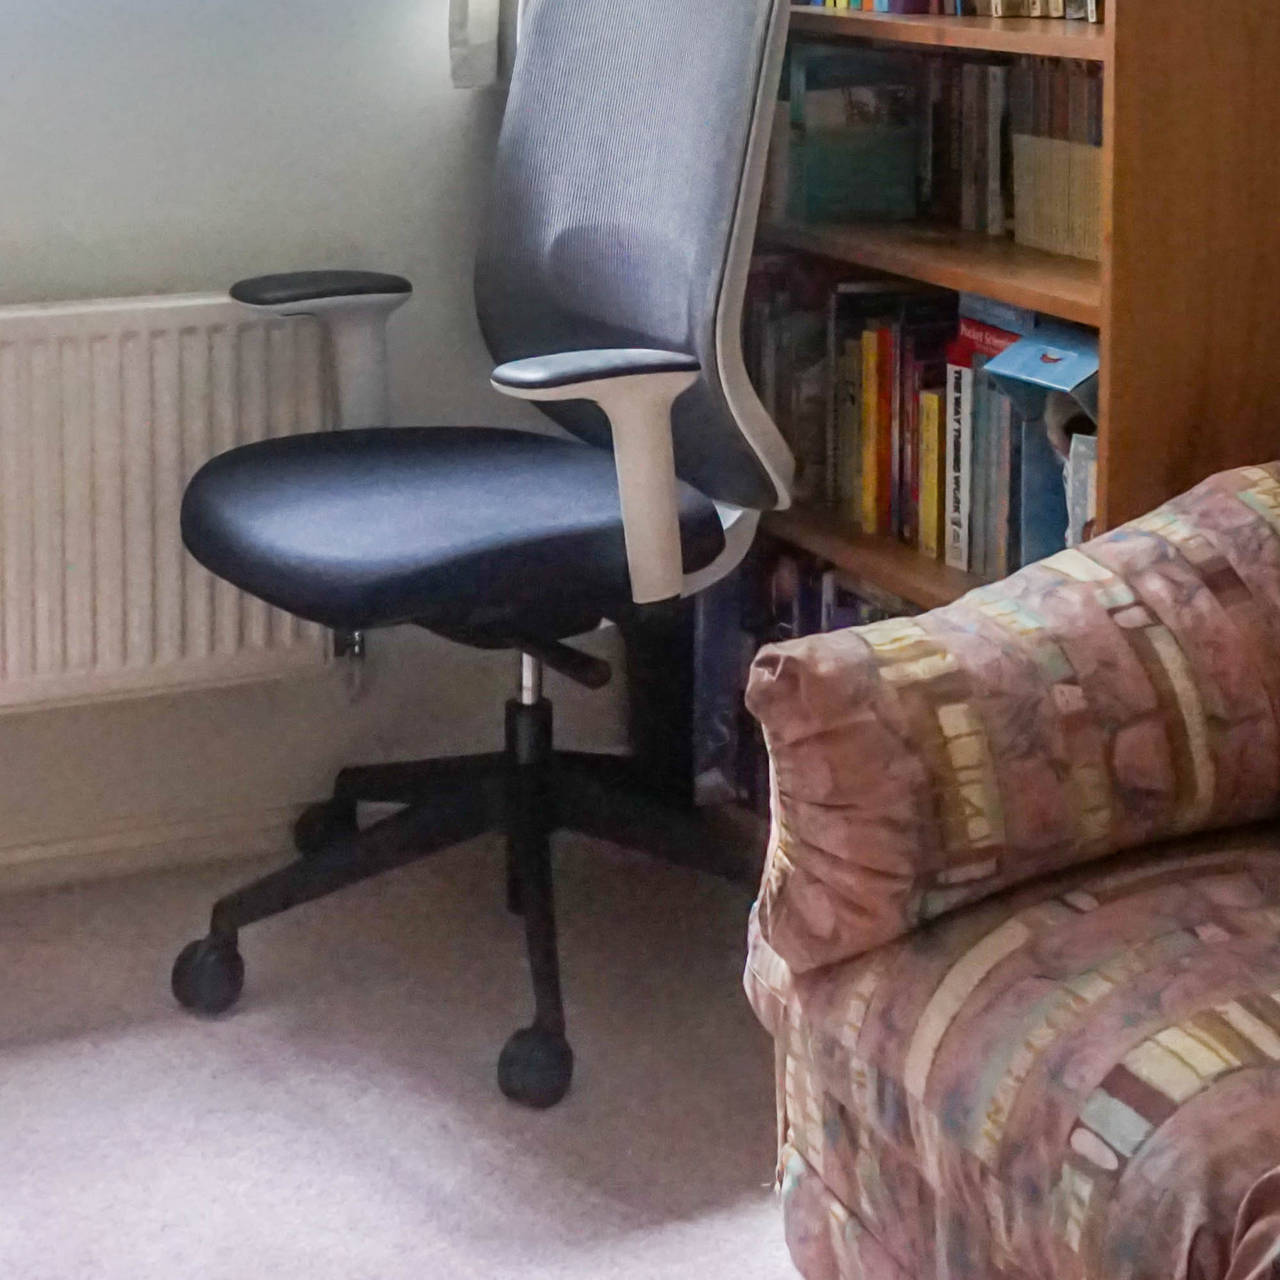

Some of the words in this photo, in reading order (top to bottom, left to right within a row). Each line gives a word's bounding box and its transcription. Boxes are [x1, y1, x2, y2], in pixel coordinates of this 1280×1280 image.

[952, 370, 962, 393] THE
[952, 395, 962, 426] WAY
[951, 476, 961, 514] WORK
